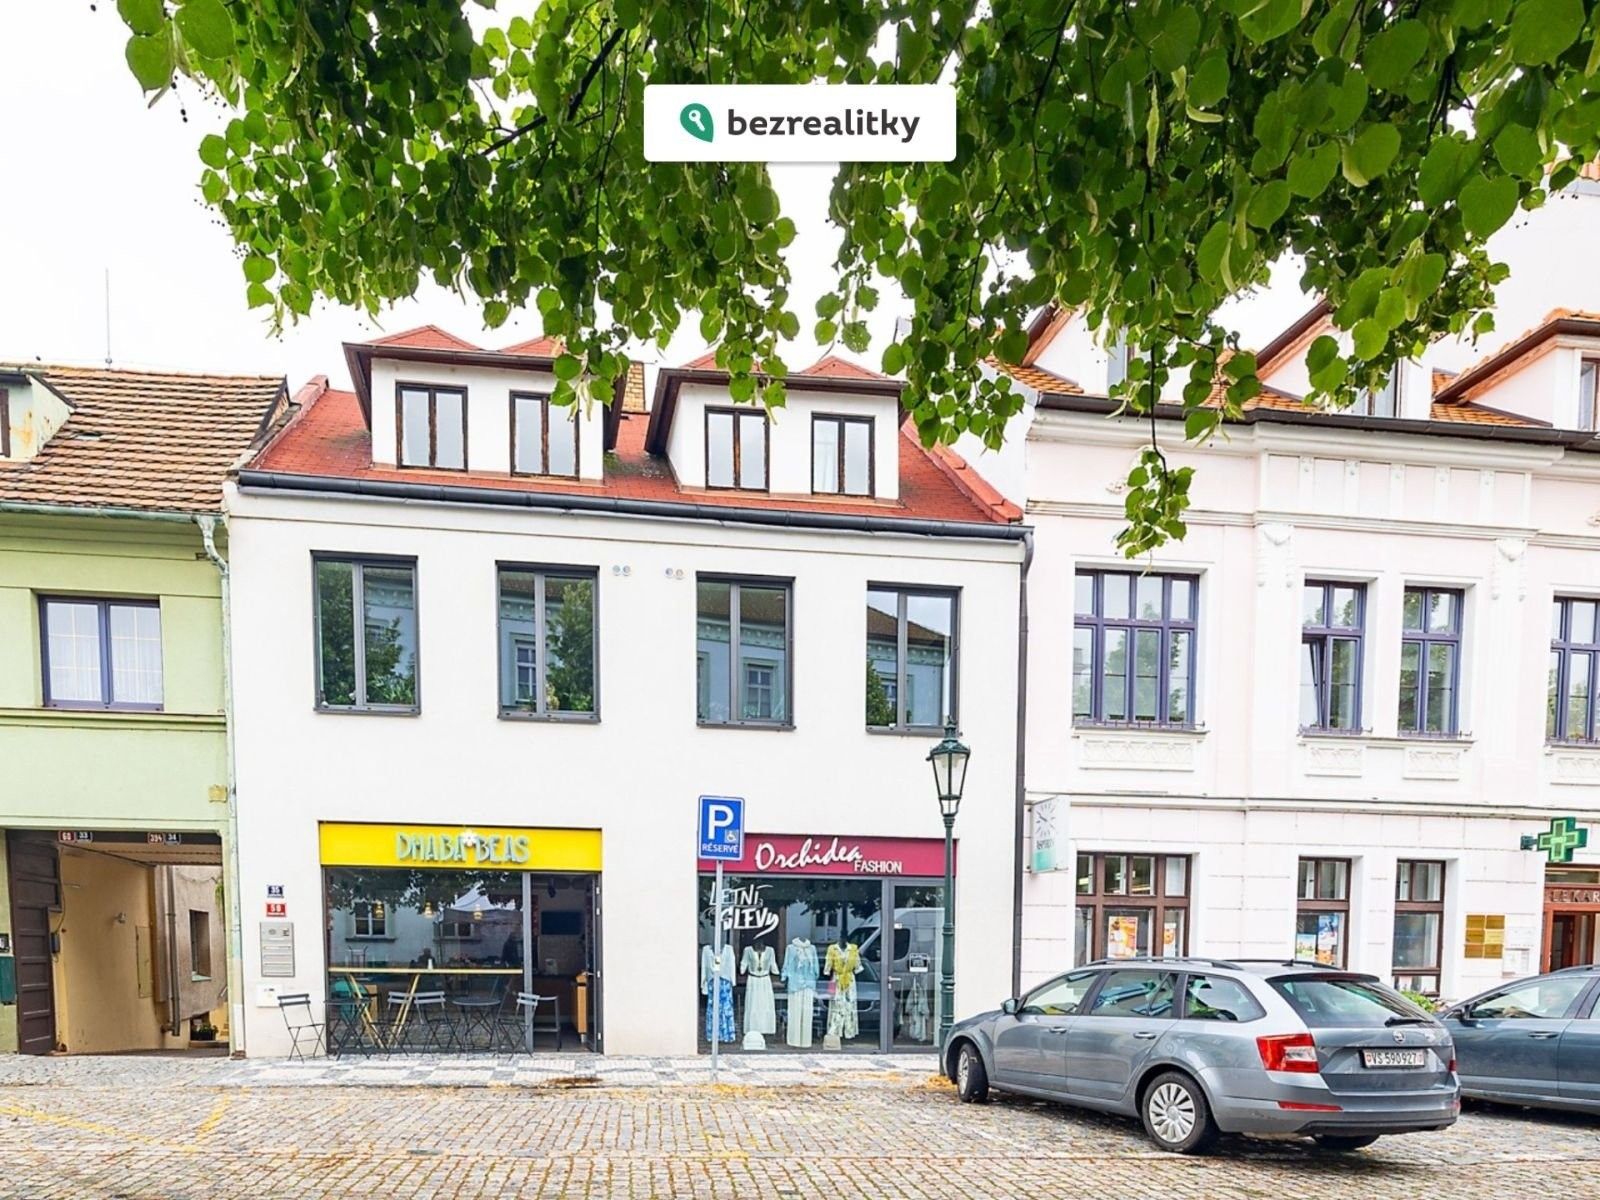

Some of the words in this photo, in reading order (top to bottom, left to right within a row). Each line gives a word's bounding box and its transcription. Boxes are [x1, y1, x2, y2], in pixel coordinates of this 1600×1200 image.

[708, 804, 734, 840] P
[475, 835, 530, 863] BEAS
[755, 837, 864, 870] Orchidea
[854, 859, 902, 873] FASHION
[1371, 1052, 1383, 1064] VS
